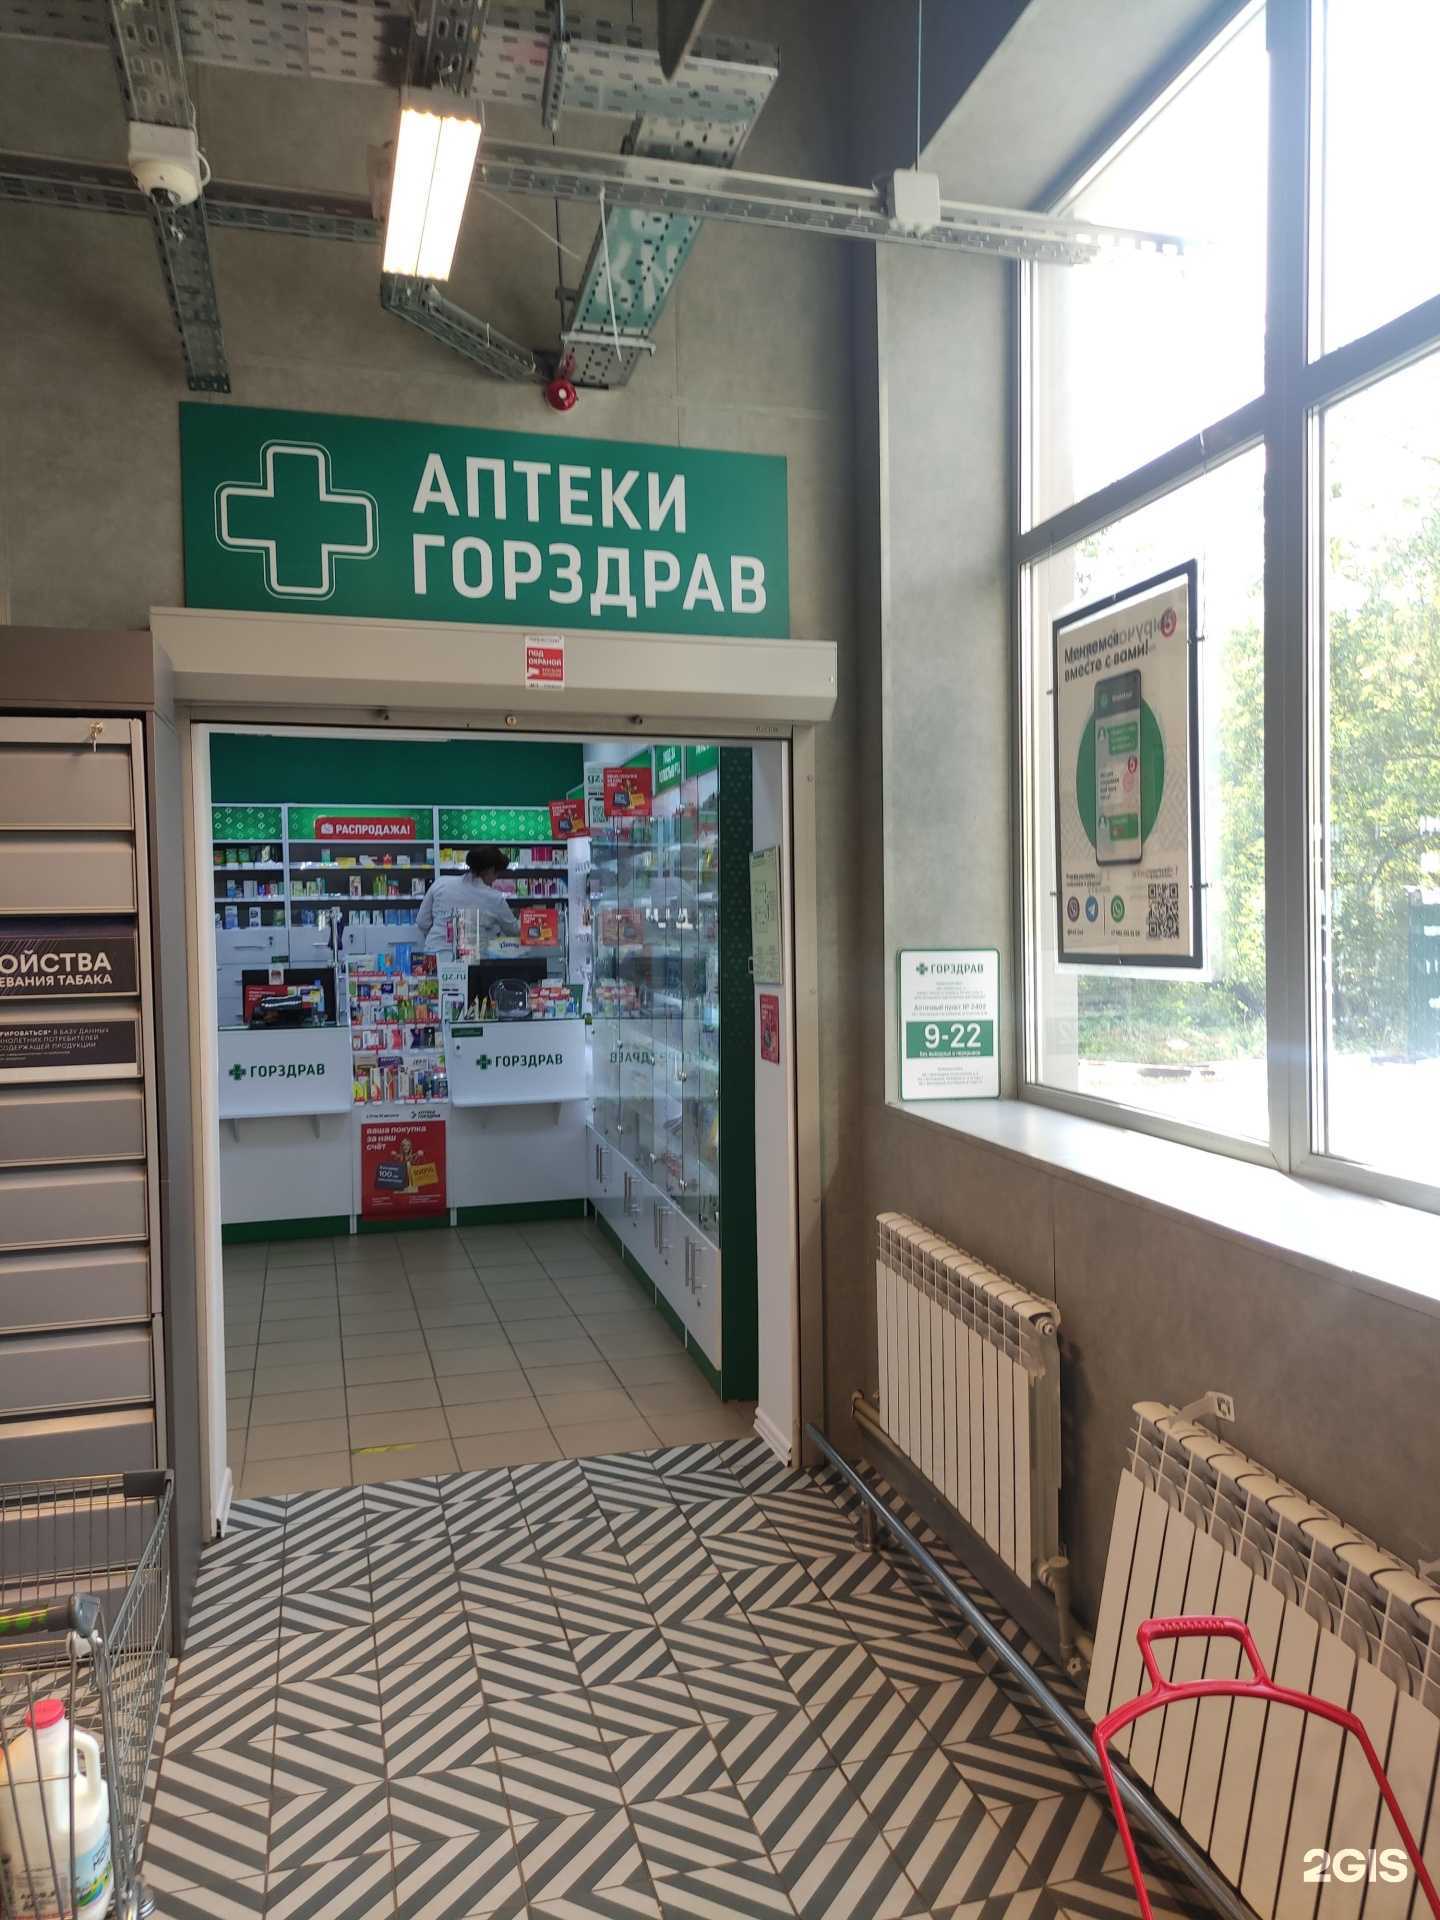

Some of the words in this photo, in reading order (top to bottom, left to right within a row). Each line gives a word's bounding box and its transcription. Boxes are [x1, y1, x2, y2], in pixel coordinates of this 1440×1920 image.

[412, 453, 686, 533] АПТЕКИ
[412, 533, 767, 618] ГОРЗДРАВ
[335, 823, 410, 836] РАСПРОДАЖА!
[0, 950, 112, 974] ОЙСТВА
[930, 963, 984, 975] ГОРЗДРАВ
[57, 973, 112, 986] ТАБАКА
[925, 1023, 982, 1049] 9-22
[495, 1053, 563, 1068] ГОРЗДРАВ
[250, 1063, 325, 1078] ГОРЗДРАВ
